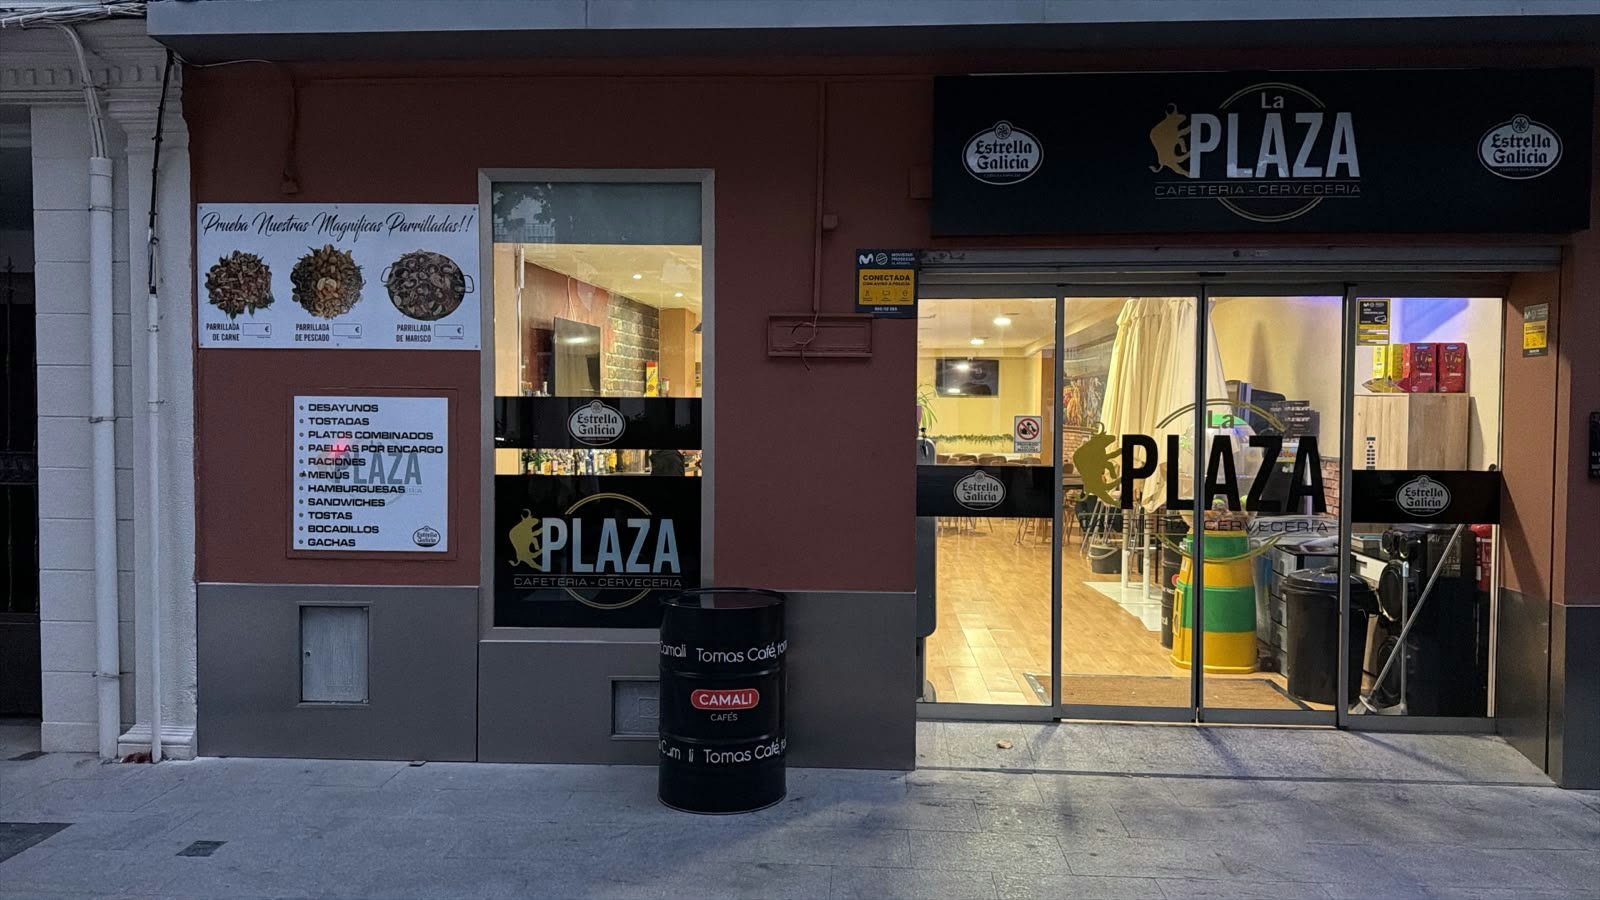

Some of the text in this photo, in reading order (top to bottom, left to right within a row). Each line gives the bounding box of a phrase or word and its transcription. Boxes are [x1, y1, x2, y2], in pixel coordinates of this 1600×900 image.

[1261, 92, 1284, 108] La
[1190, 112, 1360, 178] PLAZA
[1490, 133, 1551, 149] Estrella
[975, 140, 1032, 154] Estrella
[1492, 149, 1547, 164] Galicia
[976, 155, 1029, 170] Galicia
[1154, 185, 1244, 196] CAFETERIA
[1258, 184, 1361, 195] CERVECERIA
[201, 212, 249, 237] Prueba
[251, 212, 309, 237] Nuestras
[385, 212, 474, 236] Parrilladas!!
[206, 323, 240, 331] PARRILLADA
[295, 323, 330, 331] PARRILLADA
[396, 324, 431, 332] PARRILLADA
[212, 334, 240, 342] DE CARNE
[295, 334, 330, 342] DE PESCADO
[404, 335, 432, 343] MARISCO
[308, 404, 378, 412] DESAYUNOS
[308, 417, 370, 426] TOSTADAS
[577, 413, 618, 424] Estrella
[1207, 410, 1235, 428] La
[578, 424, 616, 435] Galicia
[308, 430, 434, 440] PLATOS COMBINADOS
[308, 444, 444, 454] PAELLAS POR ENCARGO
[308, 458, 366, 466] RACIONES
[335, 450, 422, 484] PLAZA
[1121, 434, 1327, 512] PLAZA
[308, 485, 406, 494] HAMBURGUESAS
[961, 482, 999, 494] Estrella
[1404, 488, 1443, 498] Estrella
[308, 498, 386, 506] SANDWICHES
[963, 492, 997, 502] Galicia
[1406, 497, 1442, 508] Galicia
[308, 512, 352, 520] TOSTAS
[308, 525, 380, 534] BOCADILLOS
[1204, 520, 1329, 533] CERVECERIA
[308, 538, 356, 546] GACHAS
[542, 518, 681, 573] PLAZA
[514, 577, 587, 586] CAFETERIA
[598, 578, 682, 587] CERVECERIA
[696, 648, 744, 662] Tomas
[748, 641, 776, 662] Café,
[700, 693, 752, 706] CAMALI
[710, 712, 738, 722] CAFÉS
[704, 749, 751, 764] Tomas
